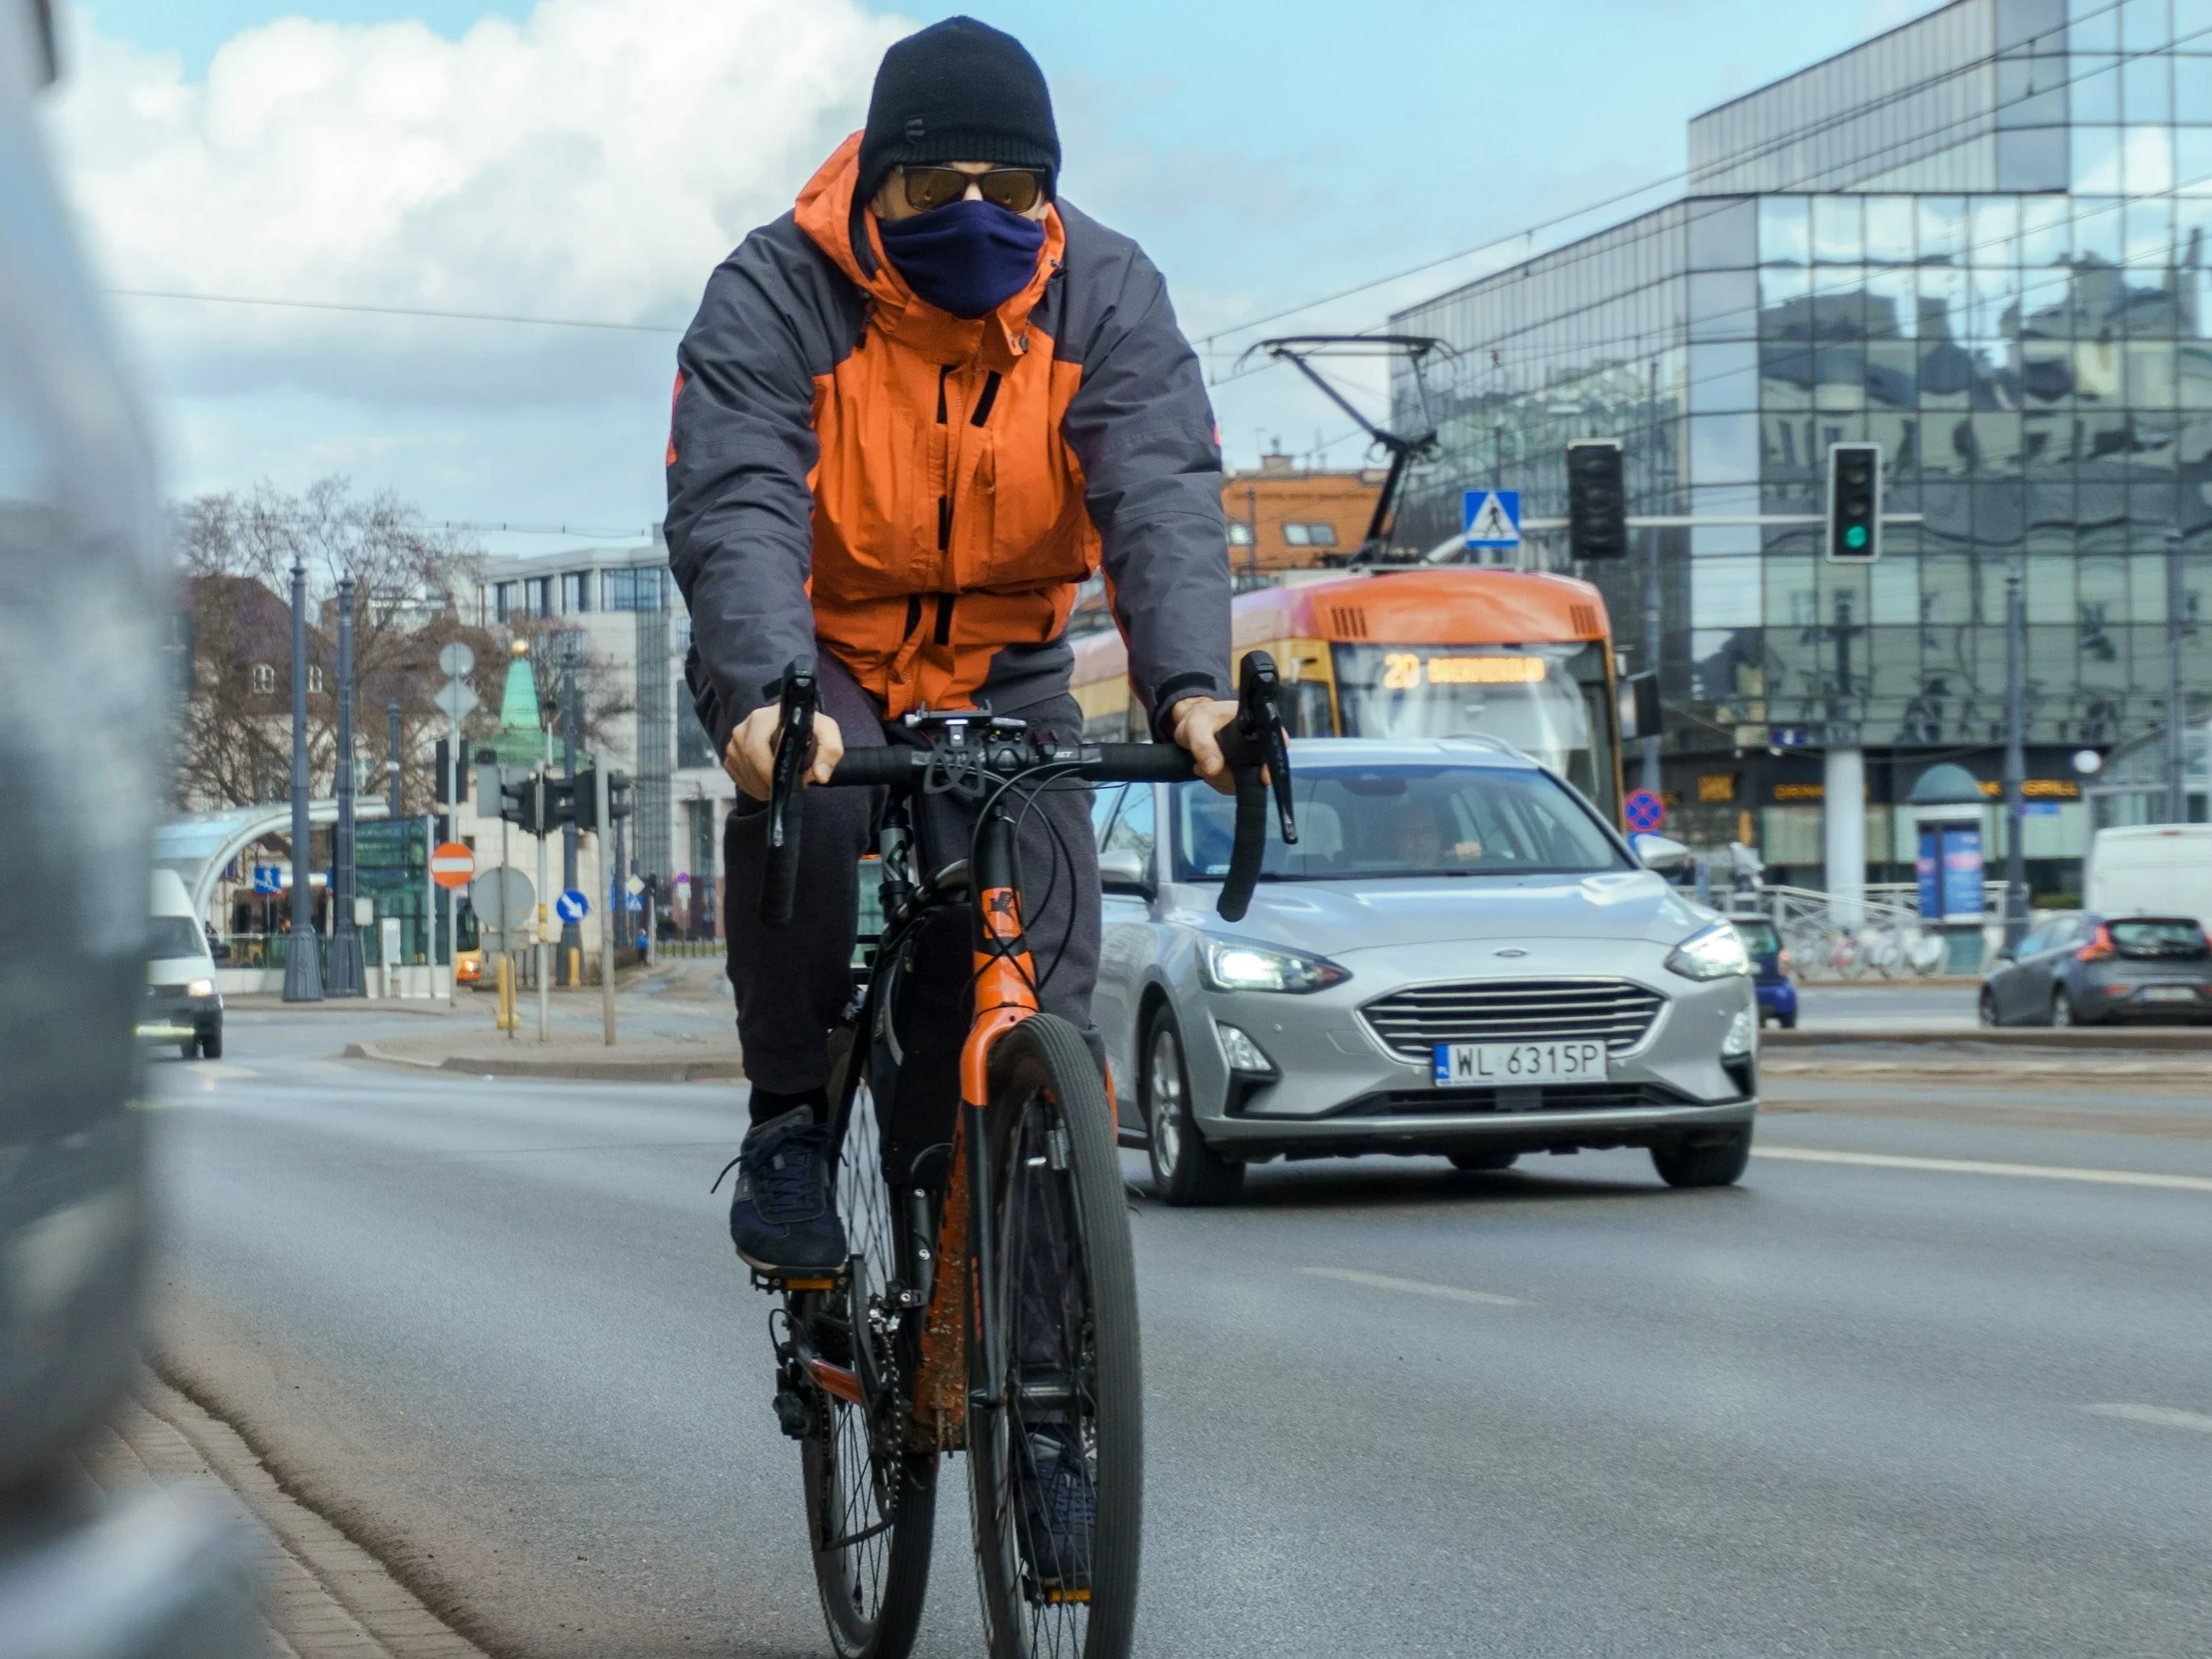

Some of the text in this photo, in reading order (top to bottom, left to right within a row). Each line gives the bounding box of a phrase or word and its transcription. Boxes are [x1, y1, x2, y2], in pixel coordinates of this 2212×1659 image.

[1384, 653, 1420, 688] 20
[2021, 780, 2080, 796] GRILL
[1456, 1045, 1598, 1076] WL 6315P
